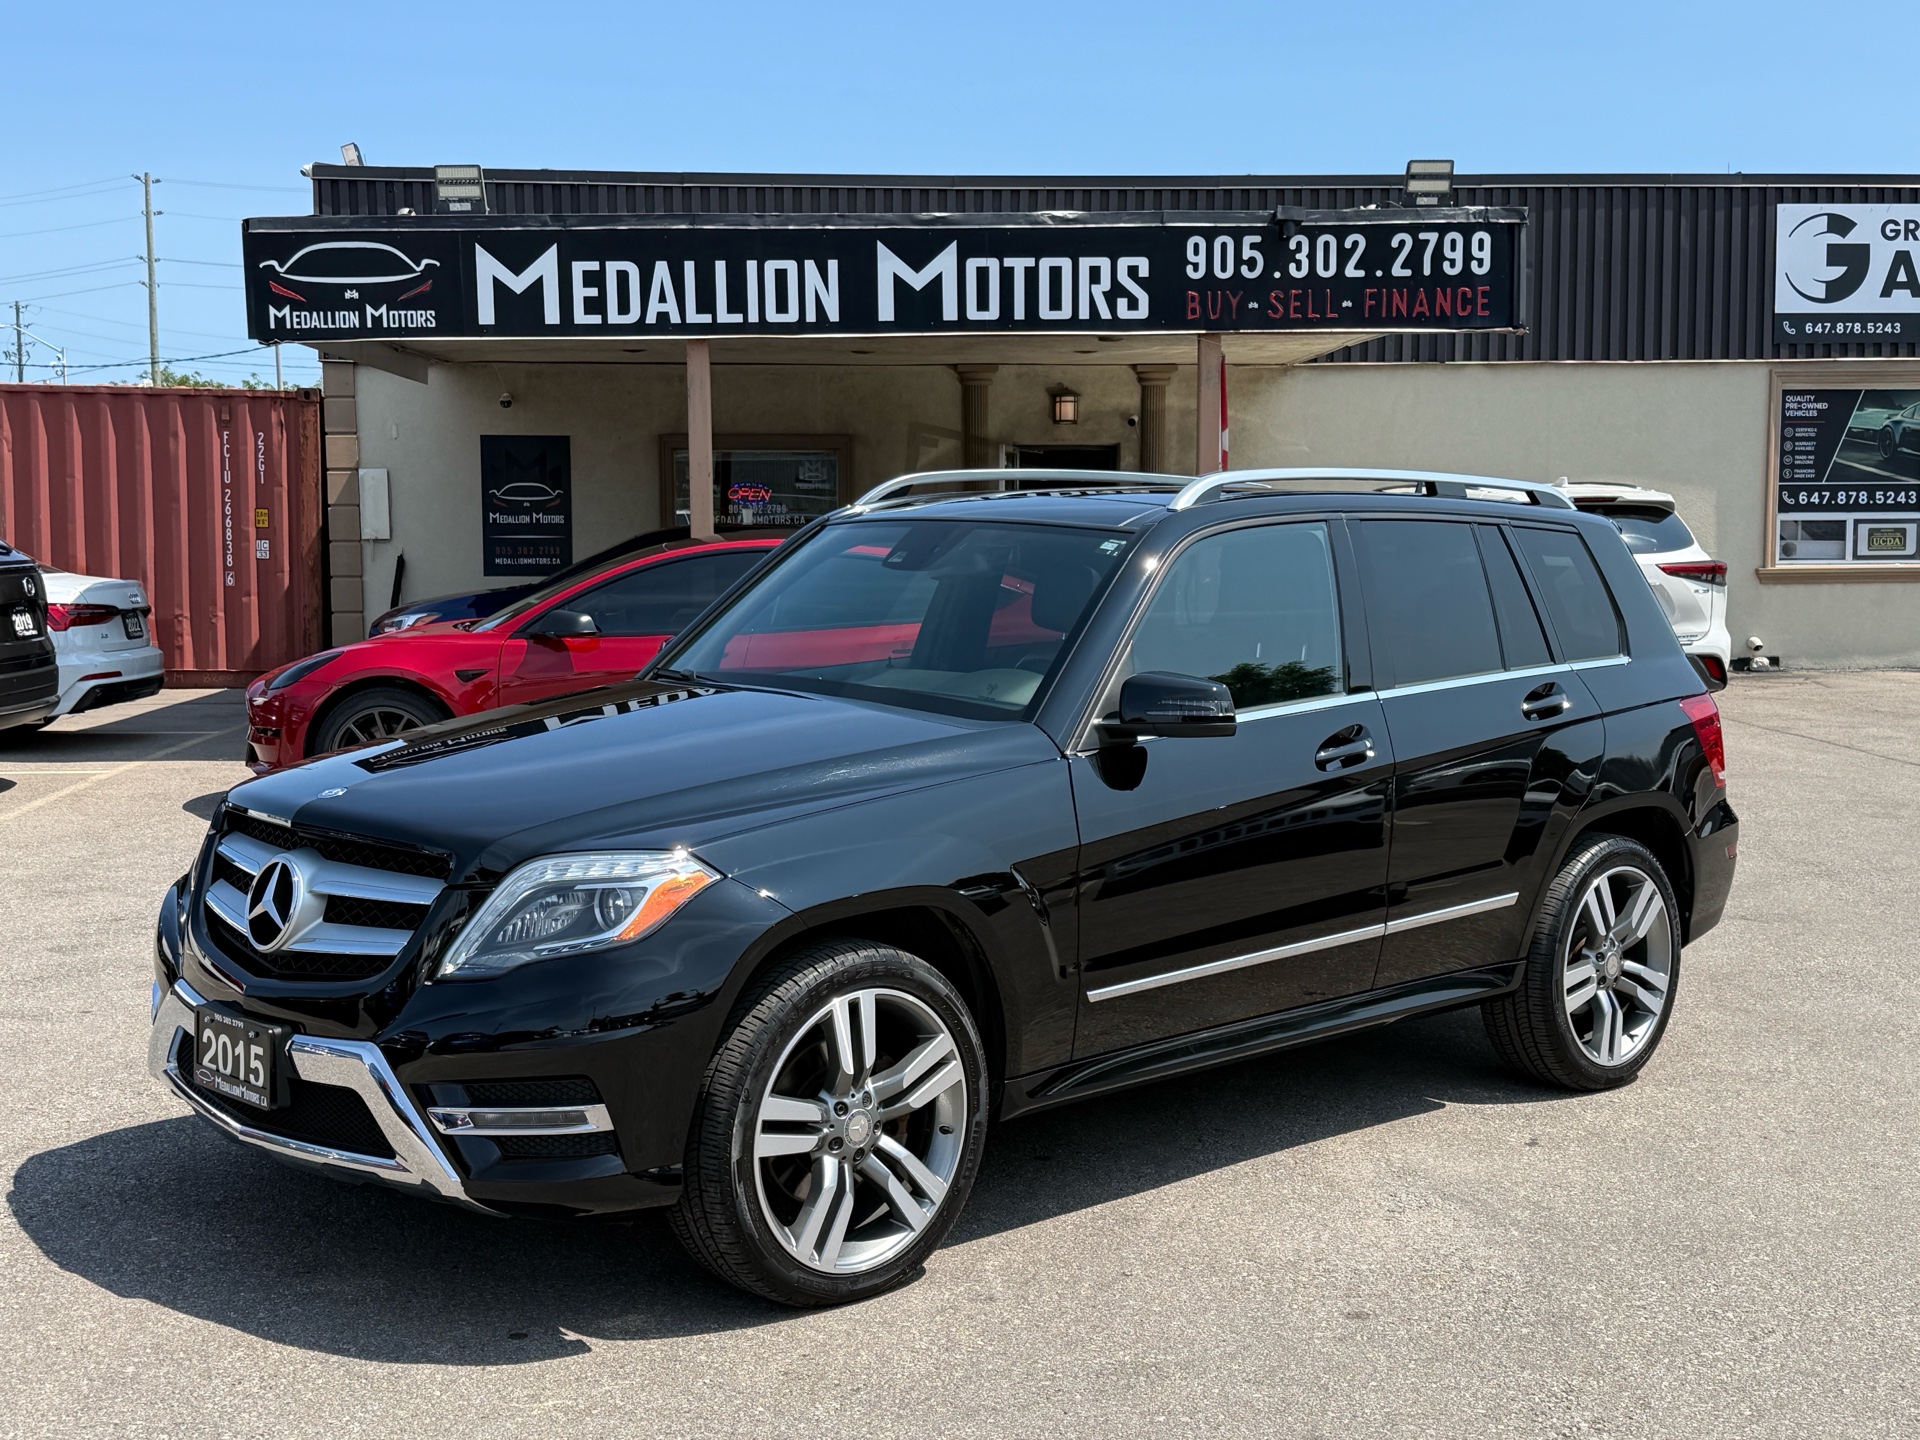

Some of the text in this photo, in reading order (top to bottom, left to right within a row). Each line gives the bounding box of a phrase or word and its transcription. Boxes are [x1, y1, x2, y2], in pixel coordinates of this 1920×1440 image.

[1880, 218, 1920, 242] GR
[1185, 231, 1491, 280] 905.302.2799
[475, 239, 1150, 325] MEDALLION MOTORS
[1879, 249, 1920, 298] A
[1186, 285, 1491, 321] BUY SELL FINANCE
[268, 303, 436, 330] MEDALLION MOTORS
[1805, 322, 1901, 334] 647.878.5243
[1785, 395, 1815, 403] QUALITY
[1785, 402, 1829, 410] PRE-OWNED
[1785, 409, 1818, 417] VEHICLES
[223, 431, 232, 484] FCIU
[257, 432, 265, 485] 22G1
[728, 487, 773, 501] OPEN
[1798, 491, 1917, 505] 647.878.5243
[224, 489, 233, 567] 266838
[489, 512, 564, 524] MEDALLION MOTORS
[1873, 537, 1901, 546] UCDA
[495, 557, 561, 565] MEDALLIONMOTORS.CA
[11, 612, 34, 631] 2019
[202, 1028, 264, 1087] 2015
